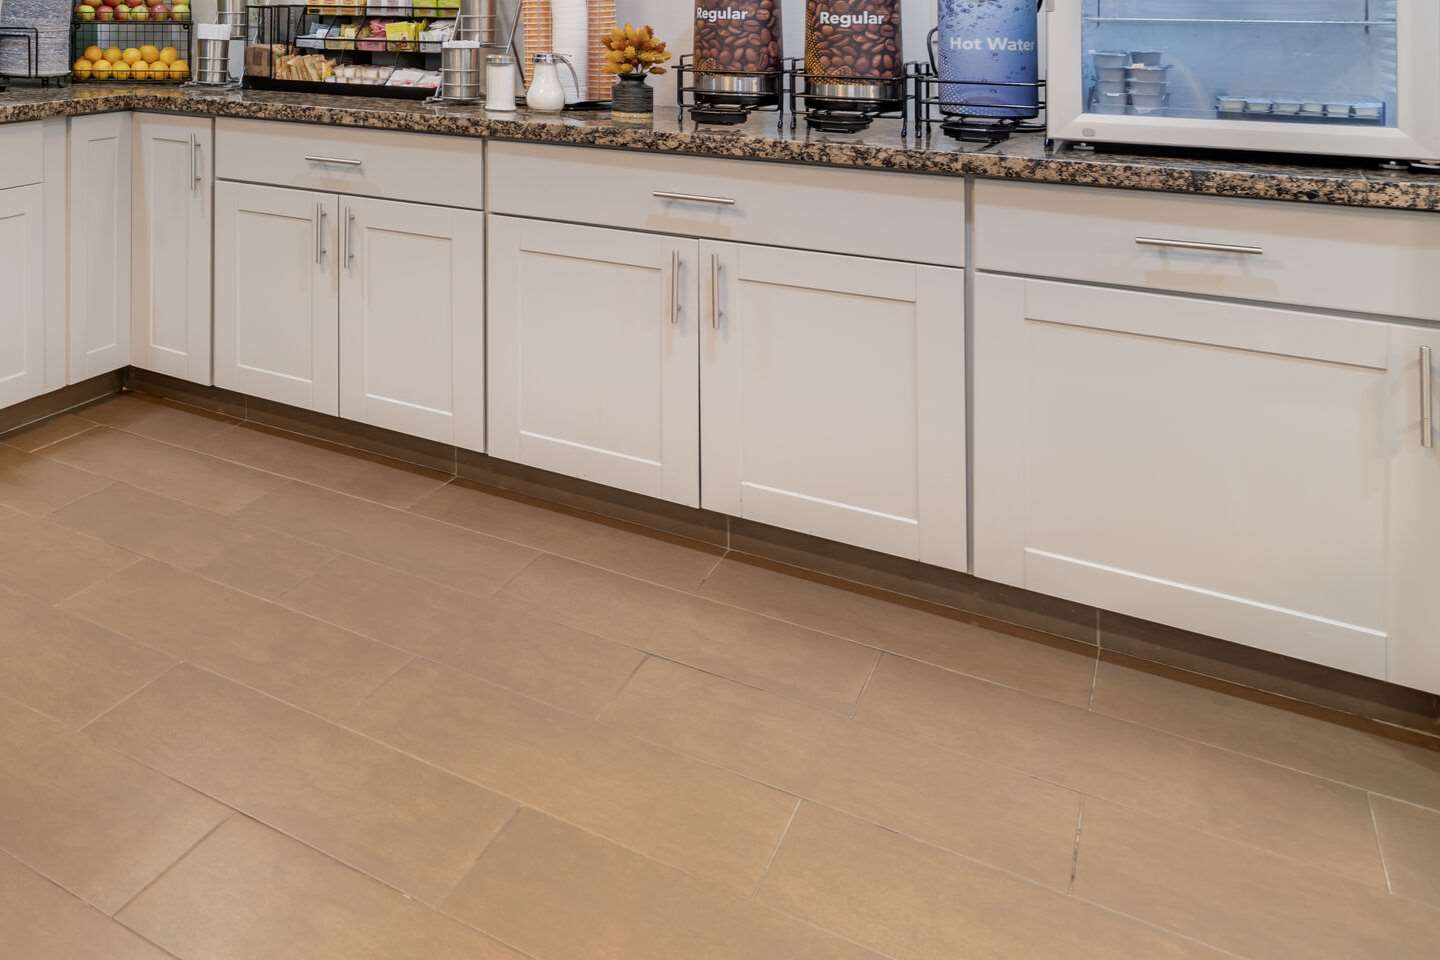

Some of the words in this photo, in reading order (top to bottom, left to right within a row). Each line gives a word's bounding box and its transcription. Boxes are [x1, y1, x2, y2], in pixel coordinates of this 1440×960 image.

[696, 7, 748, 22] Regular
[820, 12, 884, 27] Regular
[950, 37, 982, 50] Hot
[987, 37, 1035, 52] Water
